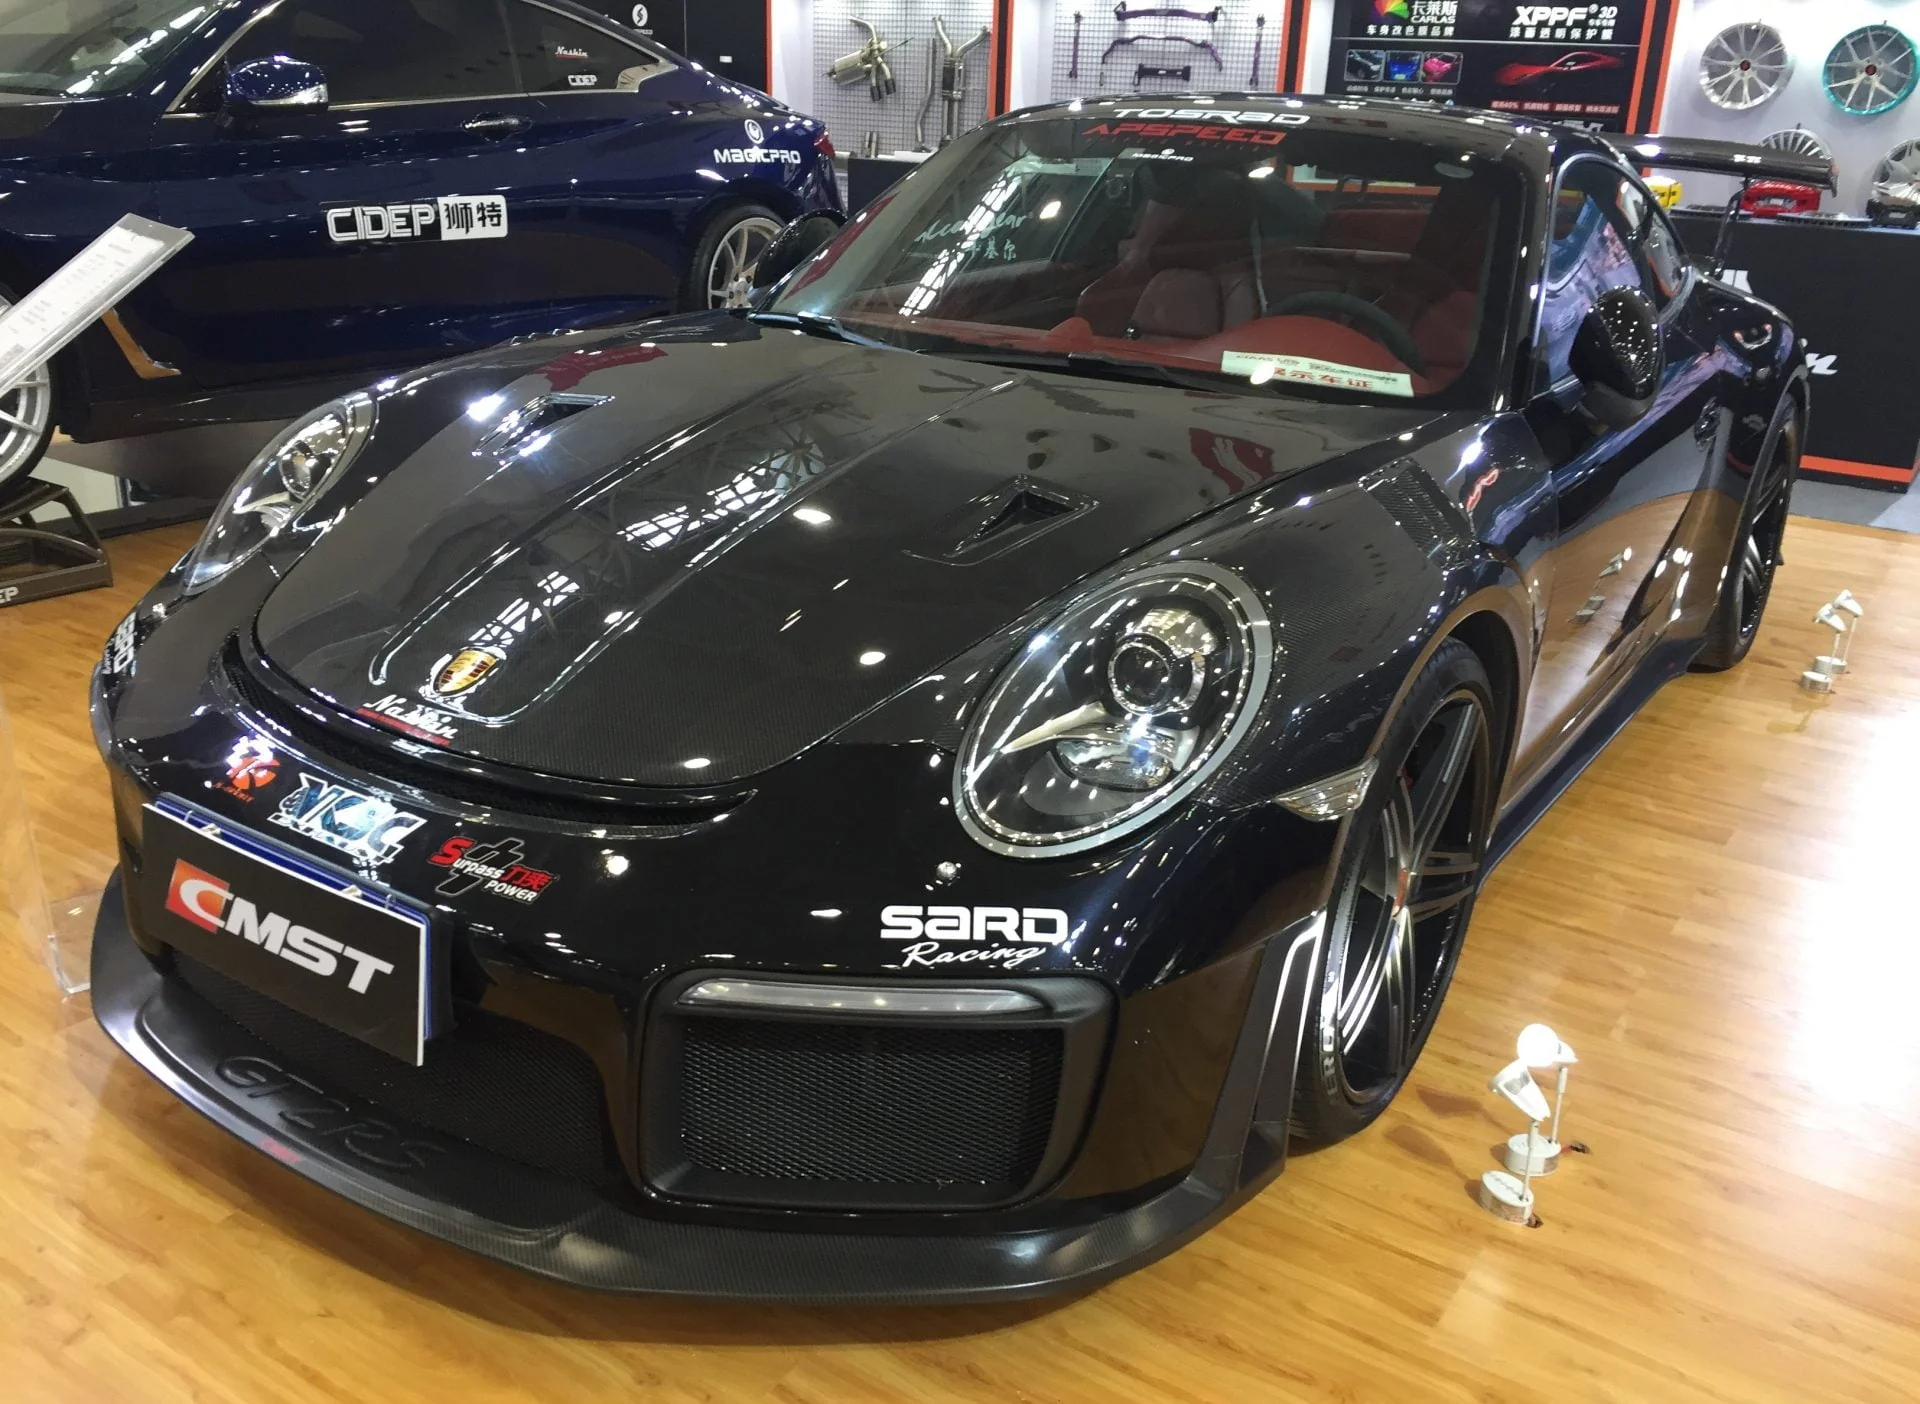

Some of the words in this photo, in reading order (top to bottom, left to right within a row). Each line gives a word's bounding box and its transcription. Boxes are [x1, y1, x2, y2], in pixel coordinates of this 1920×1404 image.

[1411, 15, 1456, 24] CARLAS
[1598, 6, 1618, 19] 3D
[567, 74, 598, 86] CIDEP
[1082, 123, 1287, 145] APSPEED
[326, 204, 436, 242] CIDEP
[444, 202, 502, 234] 狮特
[430, 836, 505, 880] Surpass
[483, 880, 538, 902] POWER
[180, 879, 395, 995] CMST
[901, 942, 1046, 968] Racing
